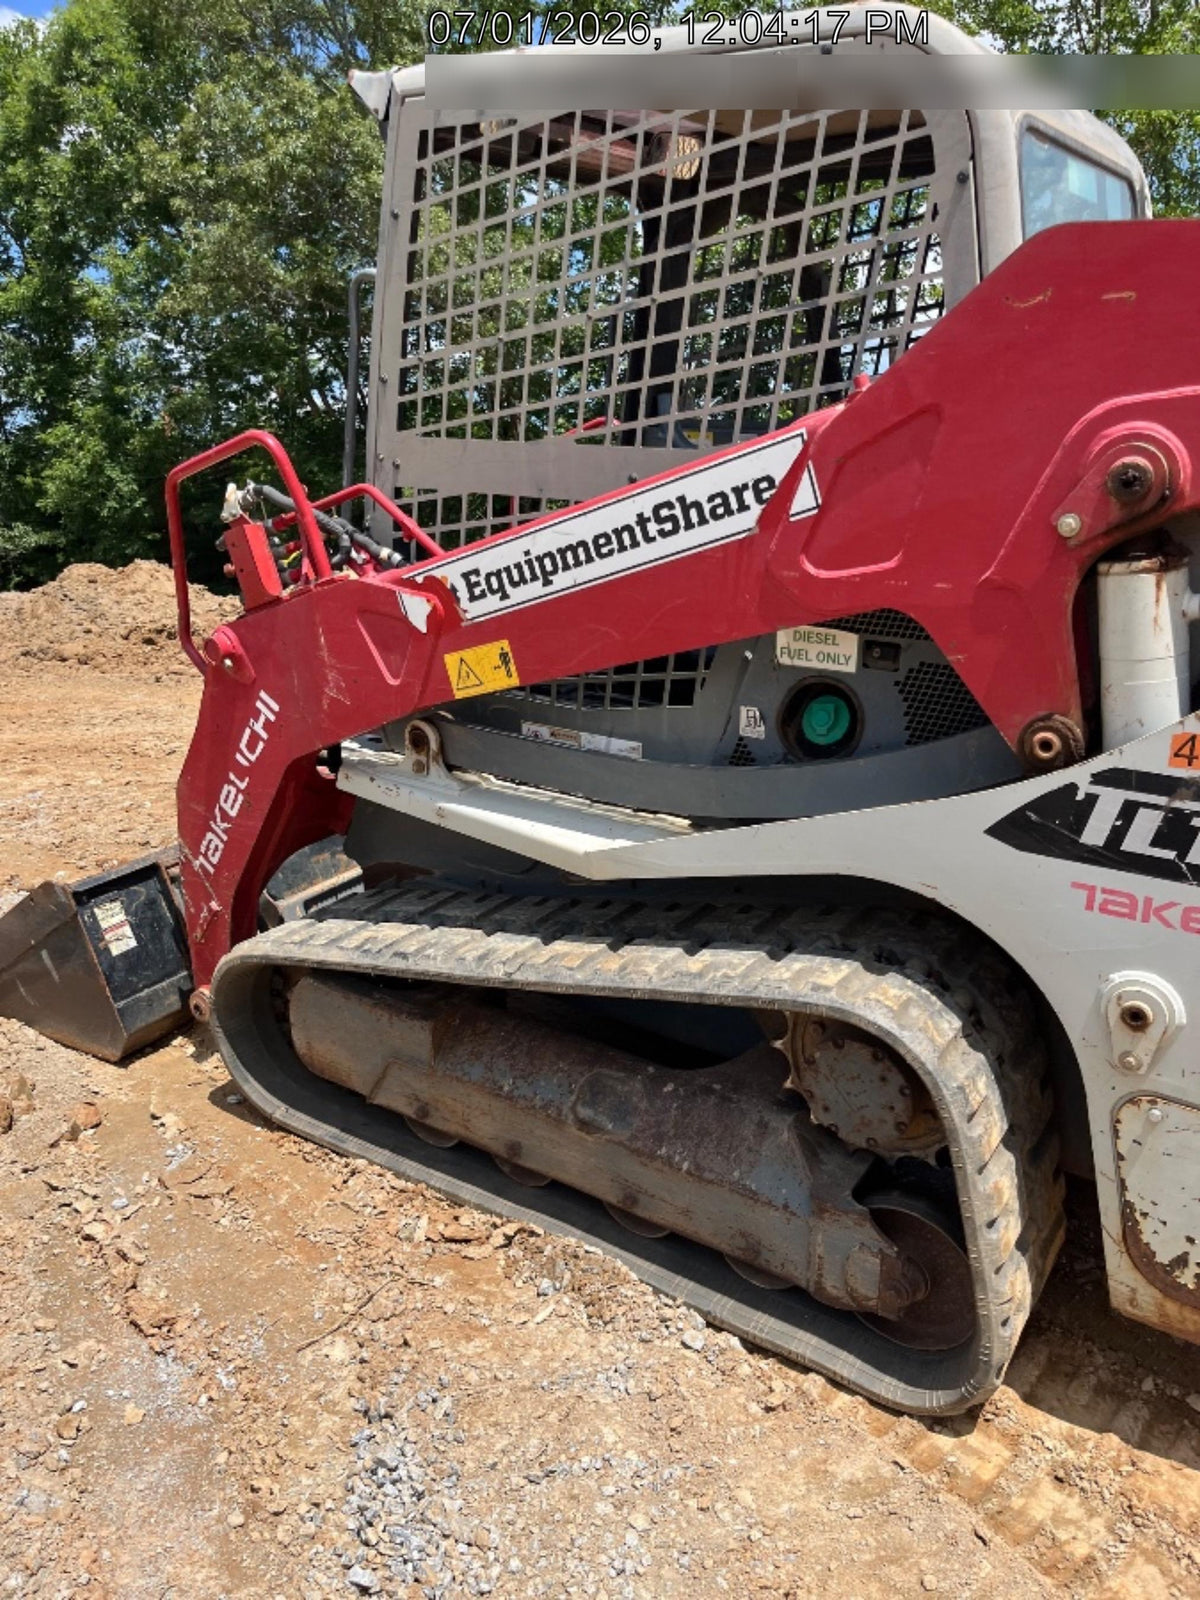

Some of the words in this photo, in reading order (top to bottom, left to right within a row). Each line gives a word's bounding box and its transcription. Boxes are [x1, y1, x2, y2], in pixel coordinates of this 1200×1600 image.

[460, 473, 777, 602] EquipmentShare
[793, 629, 840, 647] DIESEL
[780, 646, 813, 662] FUEL
[816, 650, 853, 667] ONLY
